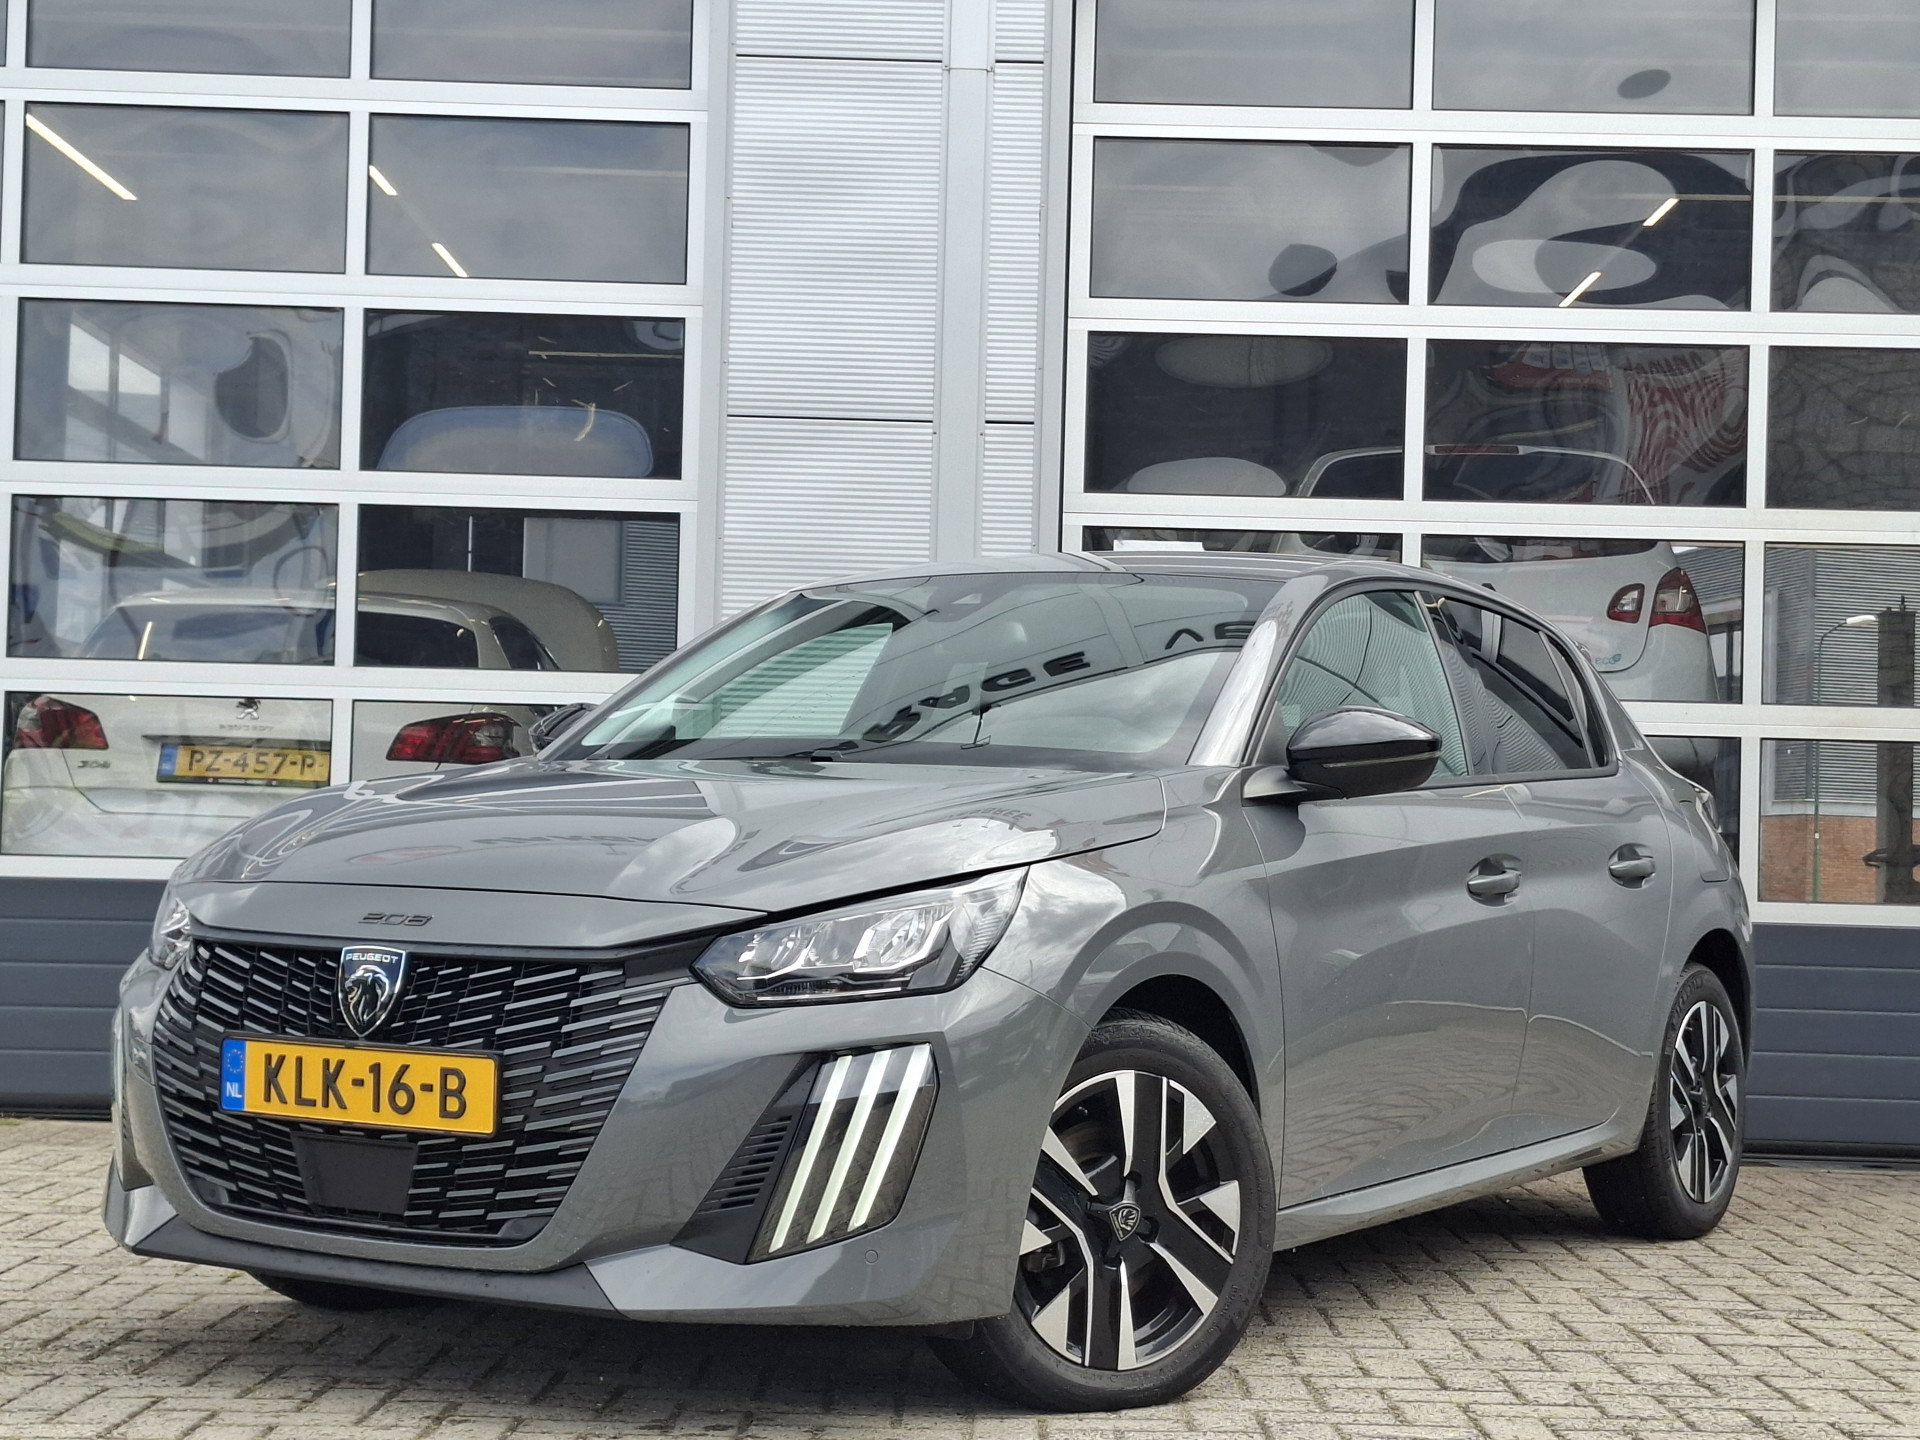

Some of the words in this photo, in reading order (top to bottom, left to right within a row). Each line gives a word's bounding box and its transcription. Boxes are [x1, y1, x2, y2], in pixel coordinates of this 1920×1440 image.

[188, 749, 316, 776] PZ-457-P
[358, 912, 432, 927] 208
[345, 952, 399, 964] PEUGEOT
[226, 1081, 242, 1098] NL
[263, 1053, 467, 1119] KLK-16-B
